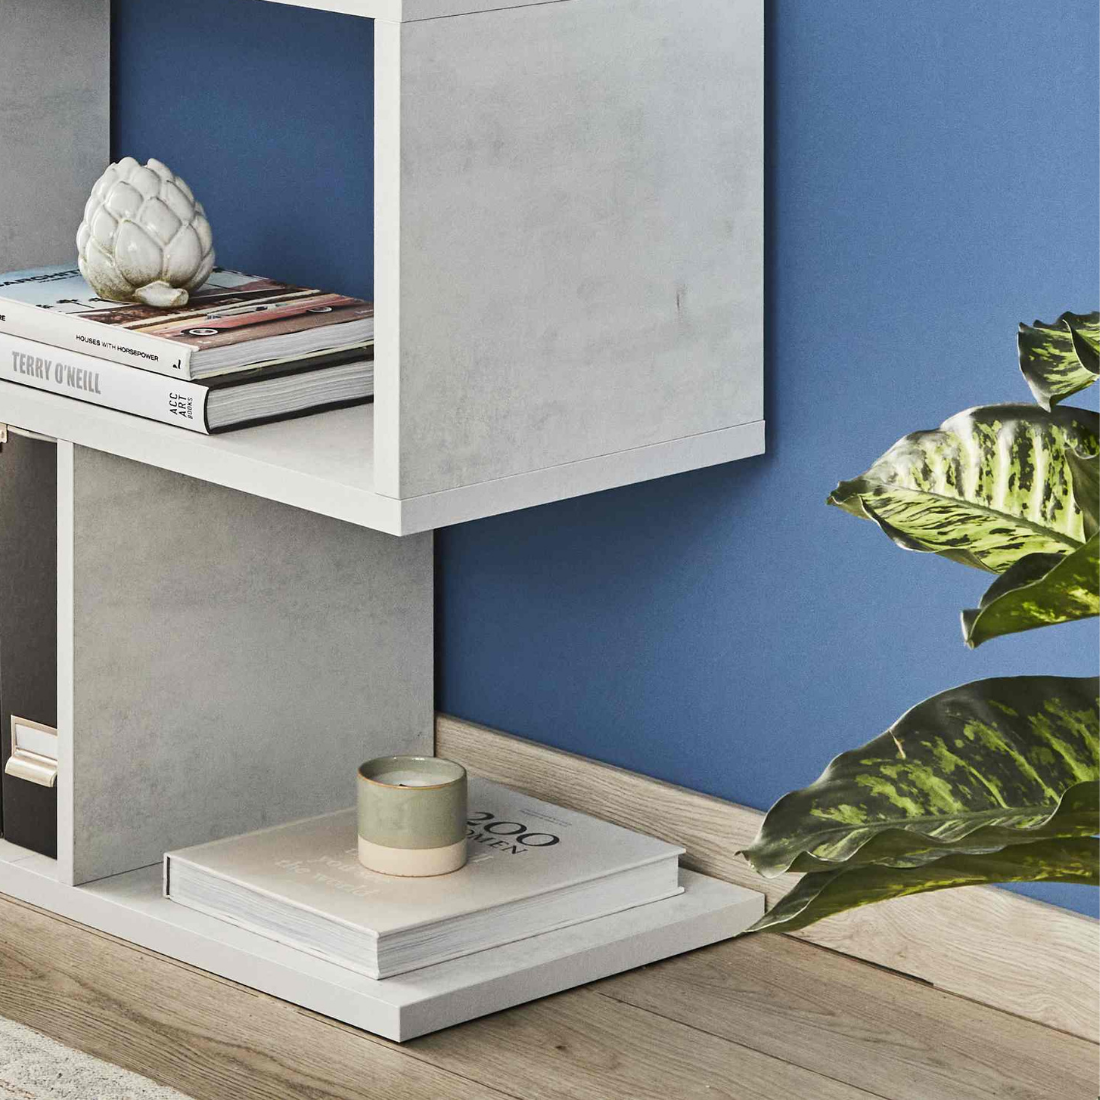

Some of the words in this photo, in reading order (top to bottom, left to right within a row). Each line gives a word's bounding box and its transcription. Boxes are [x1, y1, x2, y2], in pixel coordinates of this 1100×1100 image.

[75, 334, 101, 347] HOUSES
[101, 339, 116, 350] WITH
[116, 344, 159, 362] HORSEPOWER
[11, 350, 52, 381] TERRY
[54, 362, 102, 395] O'NEILL
[168, 392, 178, 416] ACC
[178, 394, 187, 418] ART
[467, 811, 560, 847] 200
